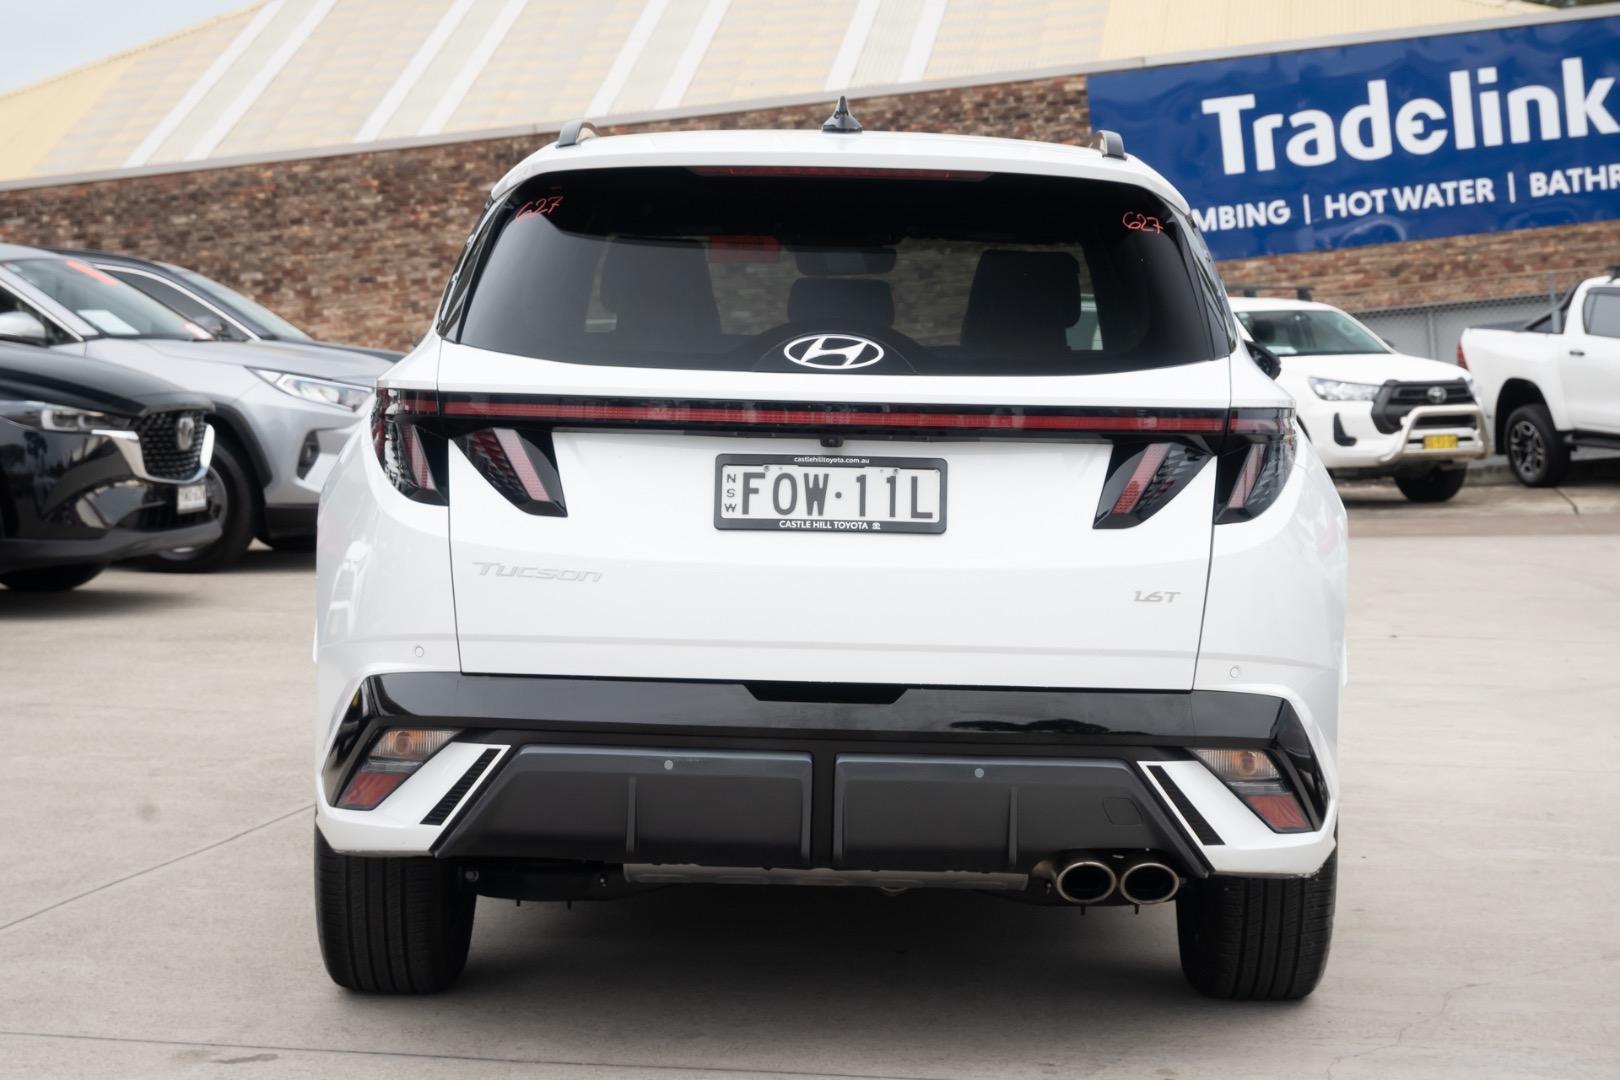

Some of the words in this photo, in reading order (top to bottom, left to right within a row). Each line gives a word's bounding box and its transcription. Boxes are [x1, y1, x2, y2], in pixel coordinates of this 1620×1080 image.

[1201, 57, 1620, 175] Tradelink
[1324, 188, 1388, 219] HOT
[1391, 177, 1496, 212] WATER
[1122, 211, 1163, 234] 627
[779, 520, 811, 528] CASTLE
[813, 521, 832, 529] HILL
[834, 522, 869, 530] TOYOTA
